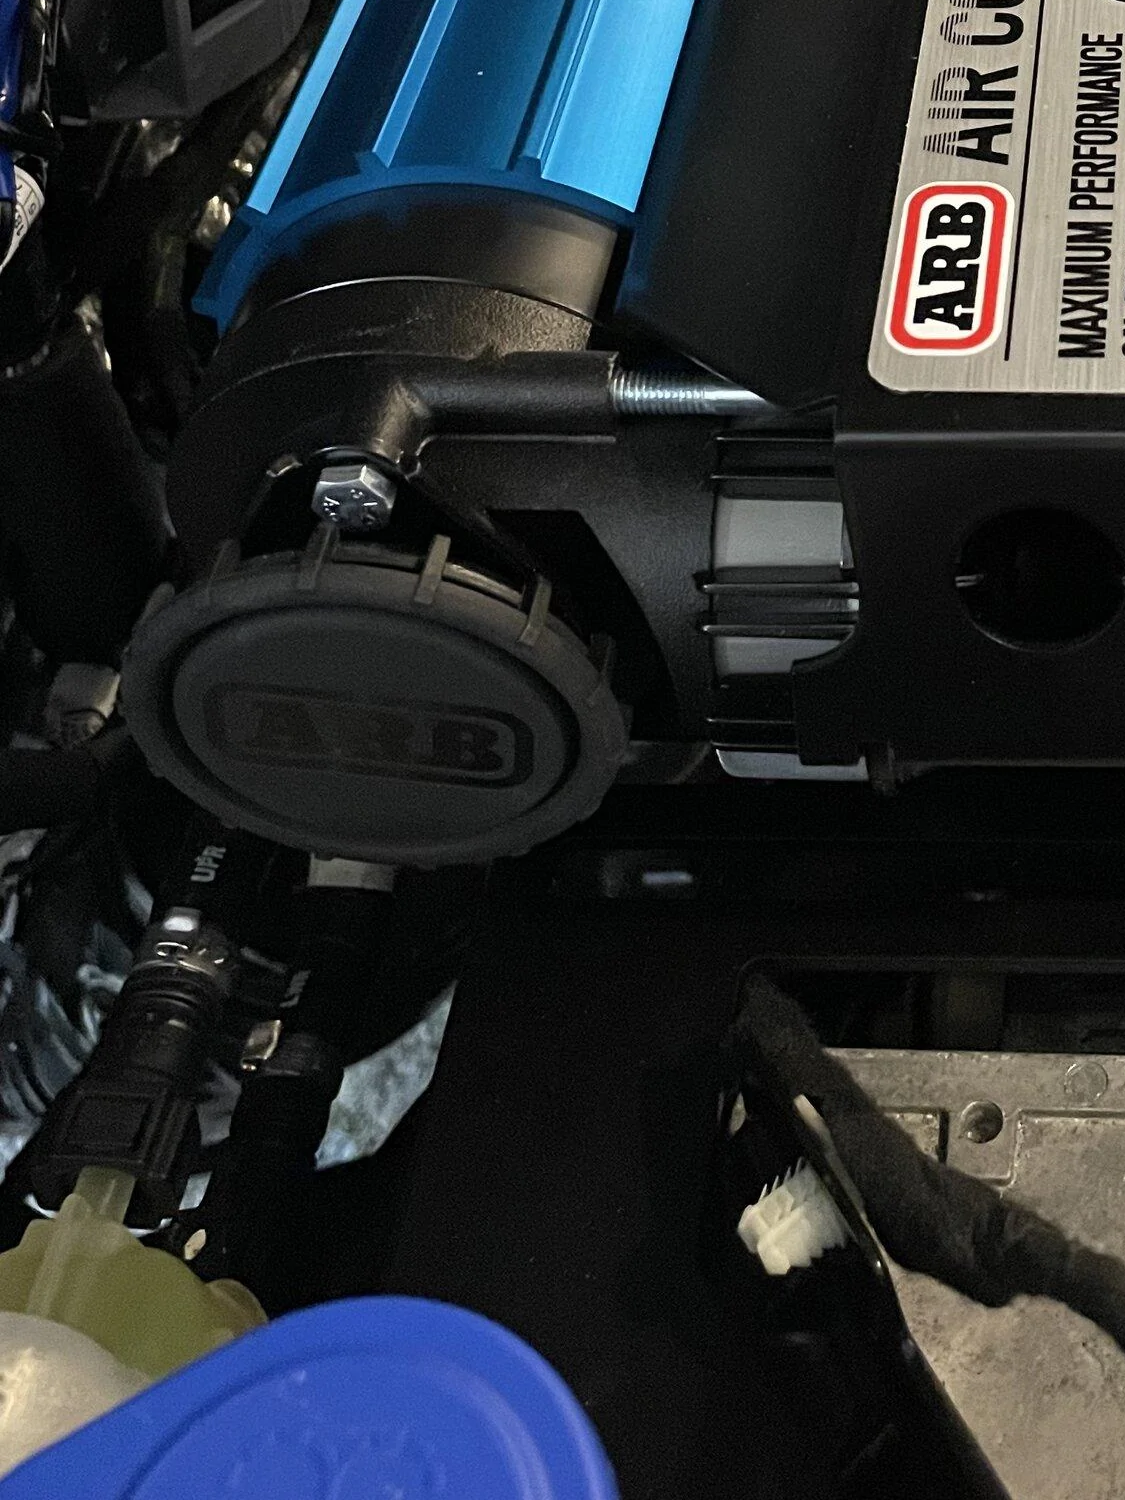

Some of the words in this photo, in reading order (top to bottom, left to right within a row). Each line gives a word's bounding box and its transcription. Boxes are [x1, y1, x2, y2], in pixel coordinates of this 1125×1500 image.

[923, 66, 1019, 165] AIR
[1069, 33, 1124, 210] PERFORMANCE
[913, 201, 986, 331] ARB
[1057, 221, 1113, 358] MAXIMUM
[240, 698, 504, 773] ARB
